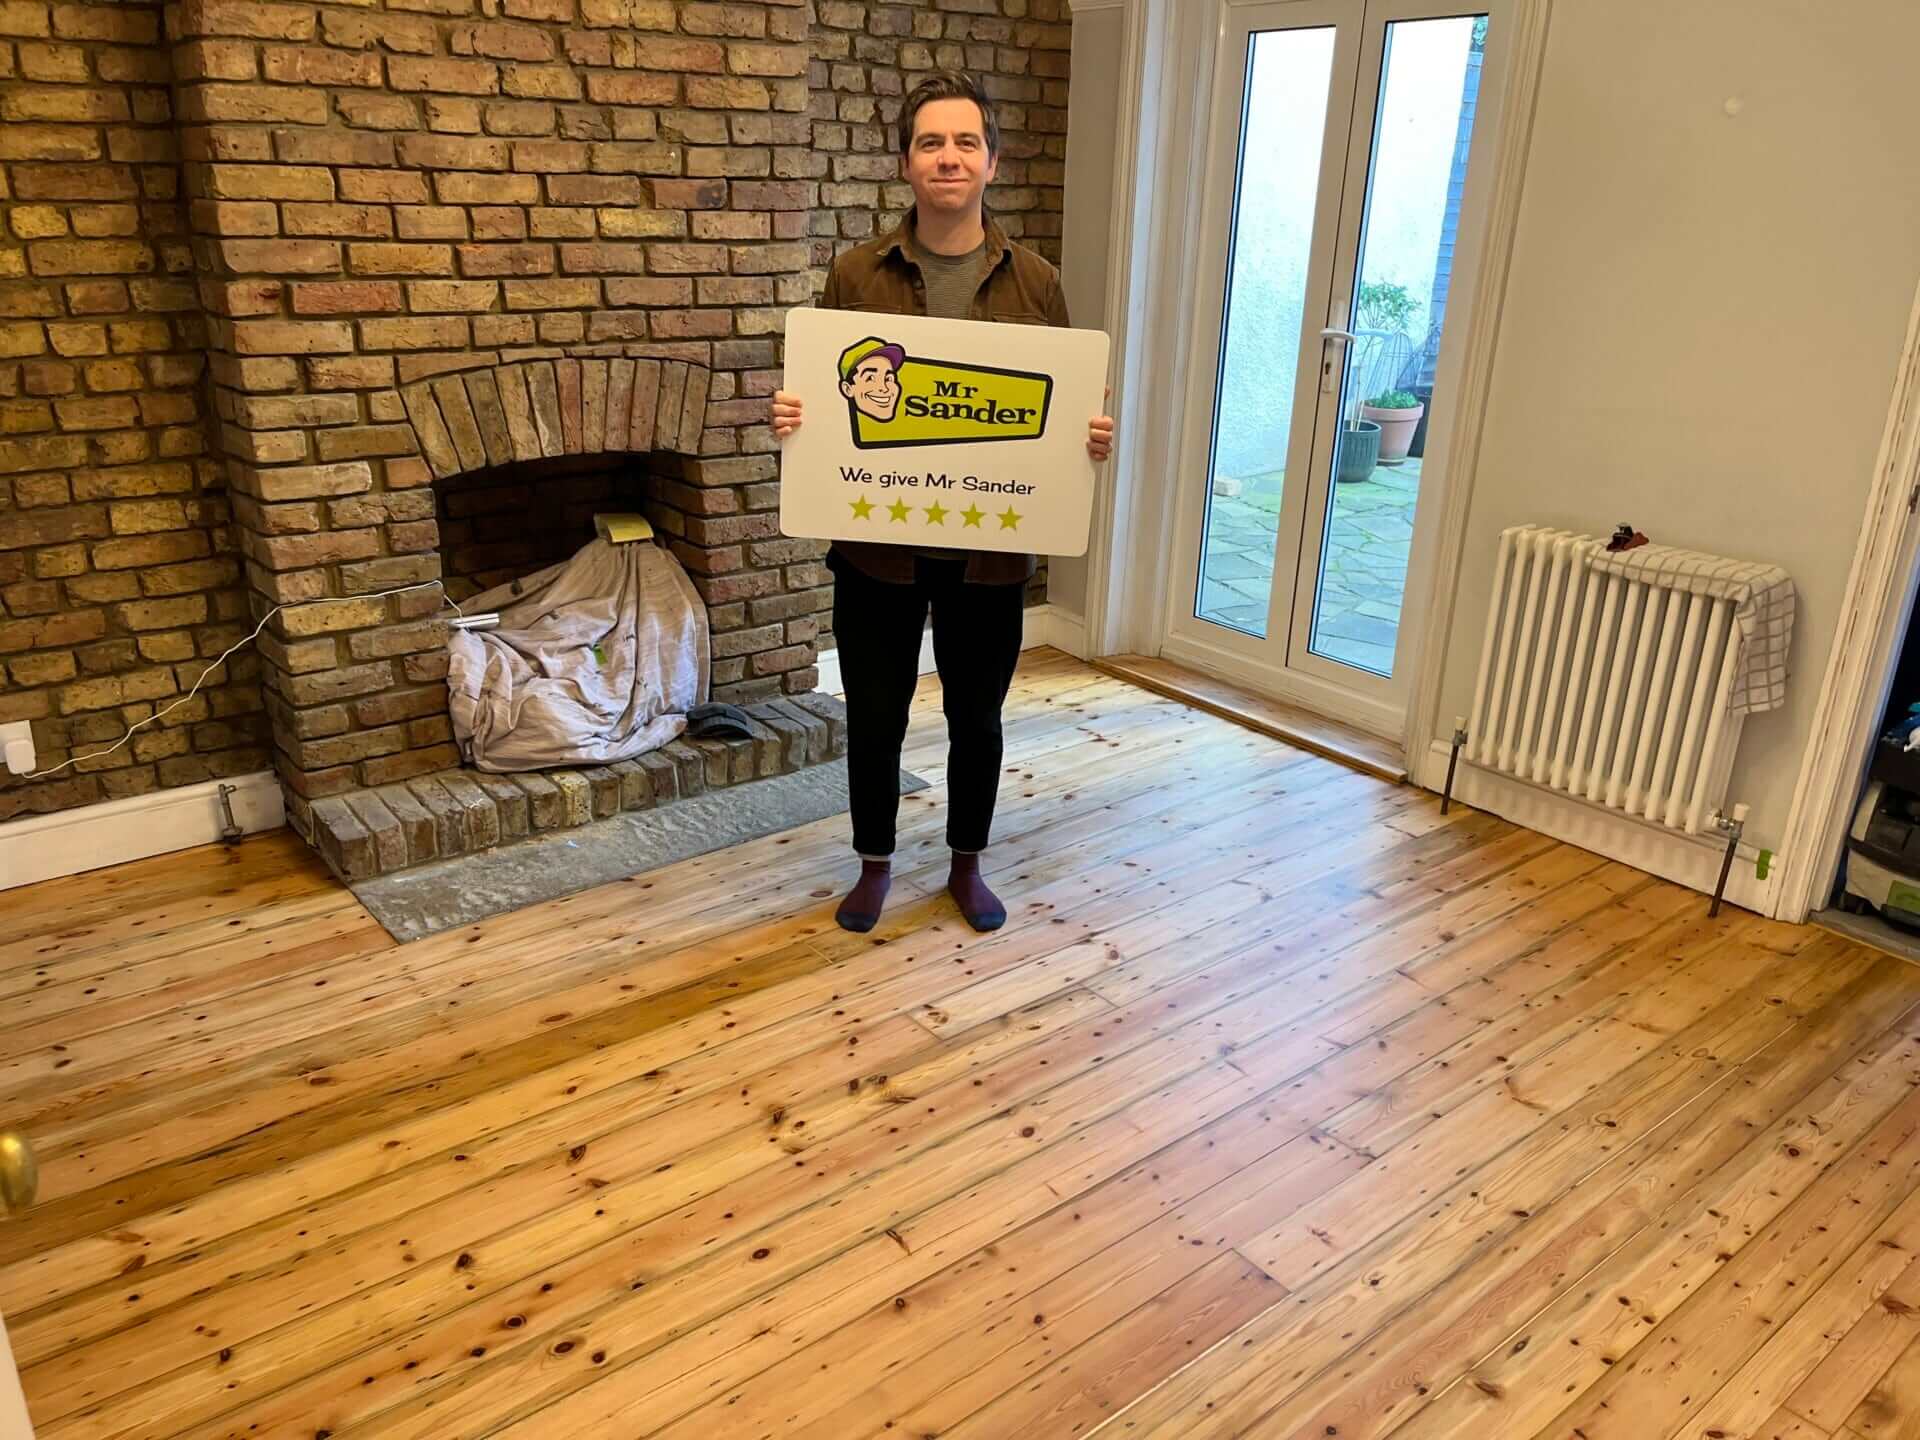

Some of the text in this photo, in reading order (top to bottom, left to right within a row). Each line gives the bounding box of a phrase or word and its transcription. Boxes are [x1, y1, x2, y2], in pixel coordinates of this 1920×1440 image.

[933, 380, 979, 399] Mr
[904, 395, 1036, 425] Sander
[839, 466, 1036, 495] We give Mr Sander
